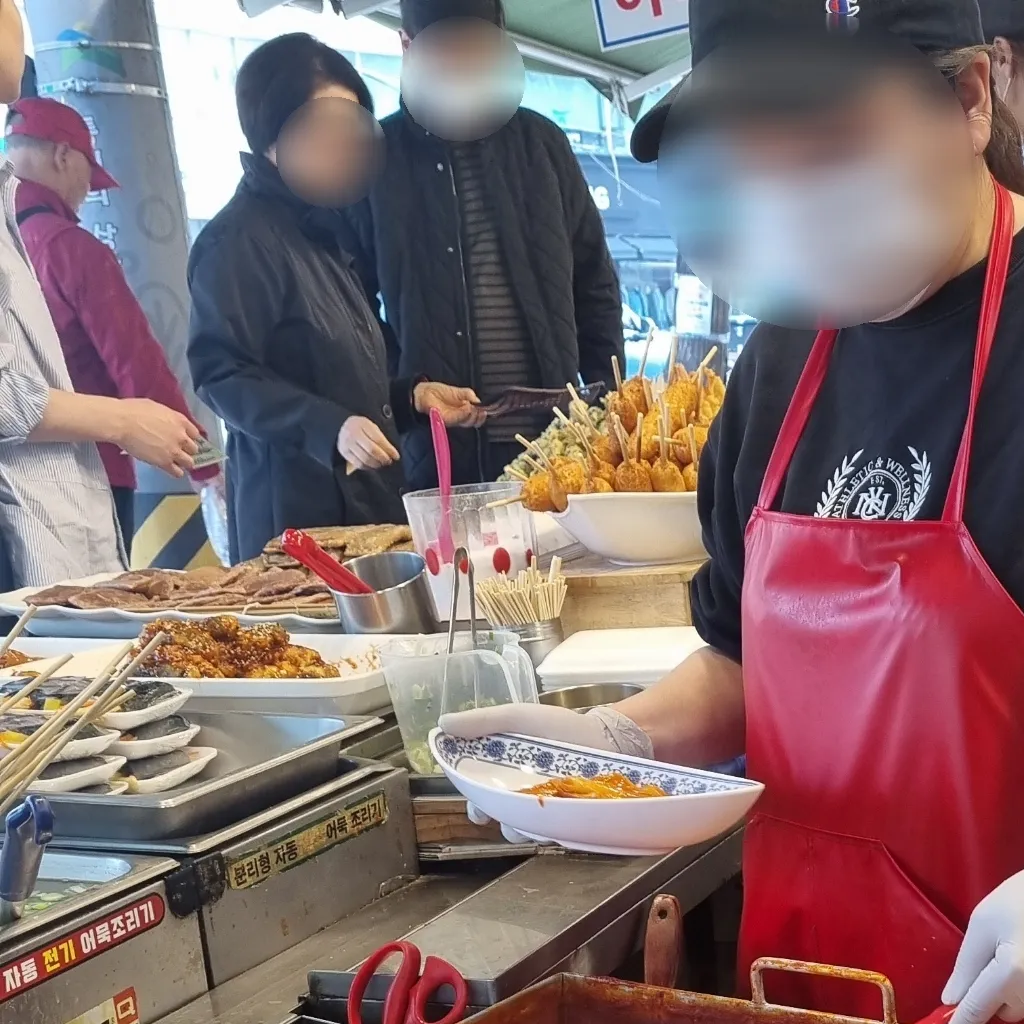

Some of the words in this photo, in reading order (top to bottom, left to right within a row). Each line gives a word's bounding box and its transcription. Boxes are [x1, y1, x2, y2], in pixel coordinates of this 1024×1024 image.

[233, 851, 271, 887] 분리형
[275, 839, 298, 866] 자동
[326, 815, 349, 840] 어묵
[350, 799, 382, 829] 조리기
[2, 957, 39, 993] 자동
[42, 938, 77, 973] 전기
[80, 900, 156, 954] 어묵조리기
